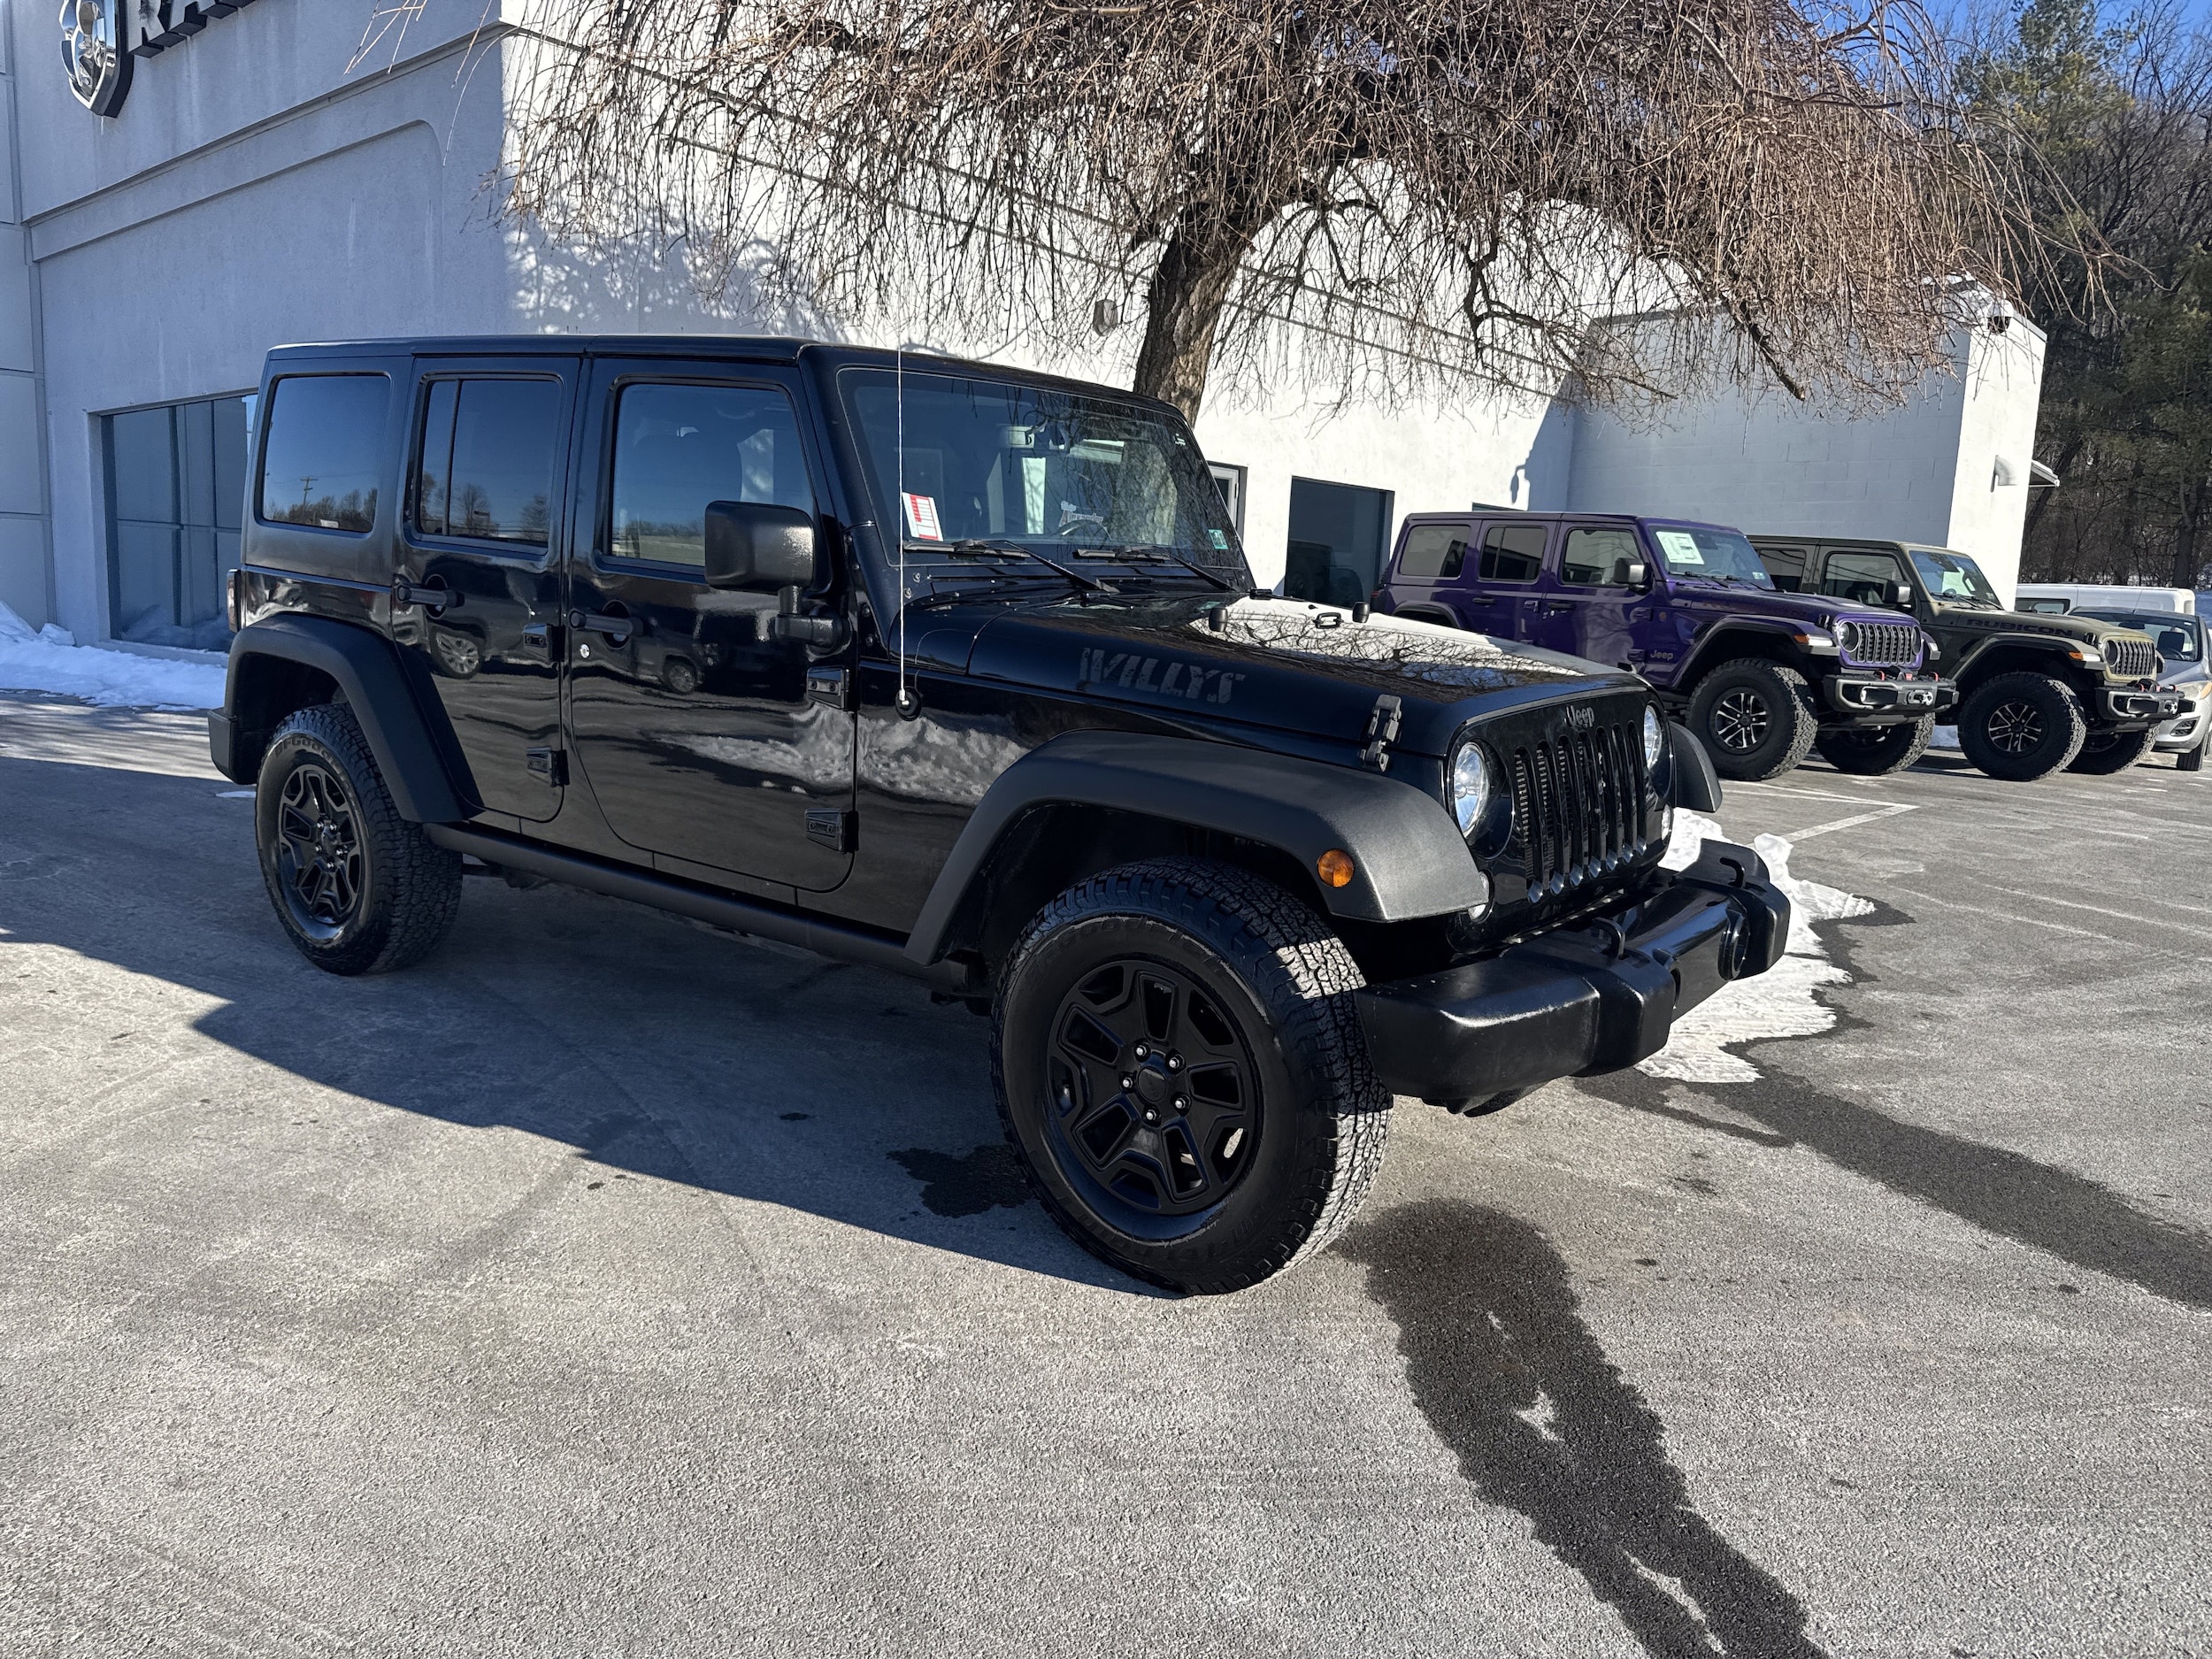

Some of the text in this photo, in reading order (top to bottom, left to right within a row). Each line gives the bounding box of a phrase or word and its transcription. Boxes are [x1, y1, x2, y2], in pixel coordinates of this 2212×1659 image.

[1966, 618, 2073, 637] RUBICON
[1649, 649, 1674, 661] Jeep
[1079, 648, 1246, 703] WILLYS
[1564, 705, 1595, 728] Jeep
